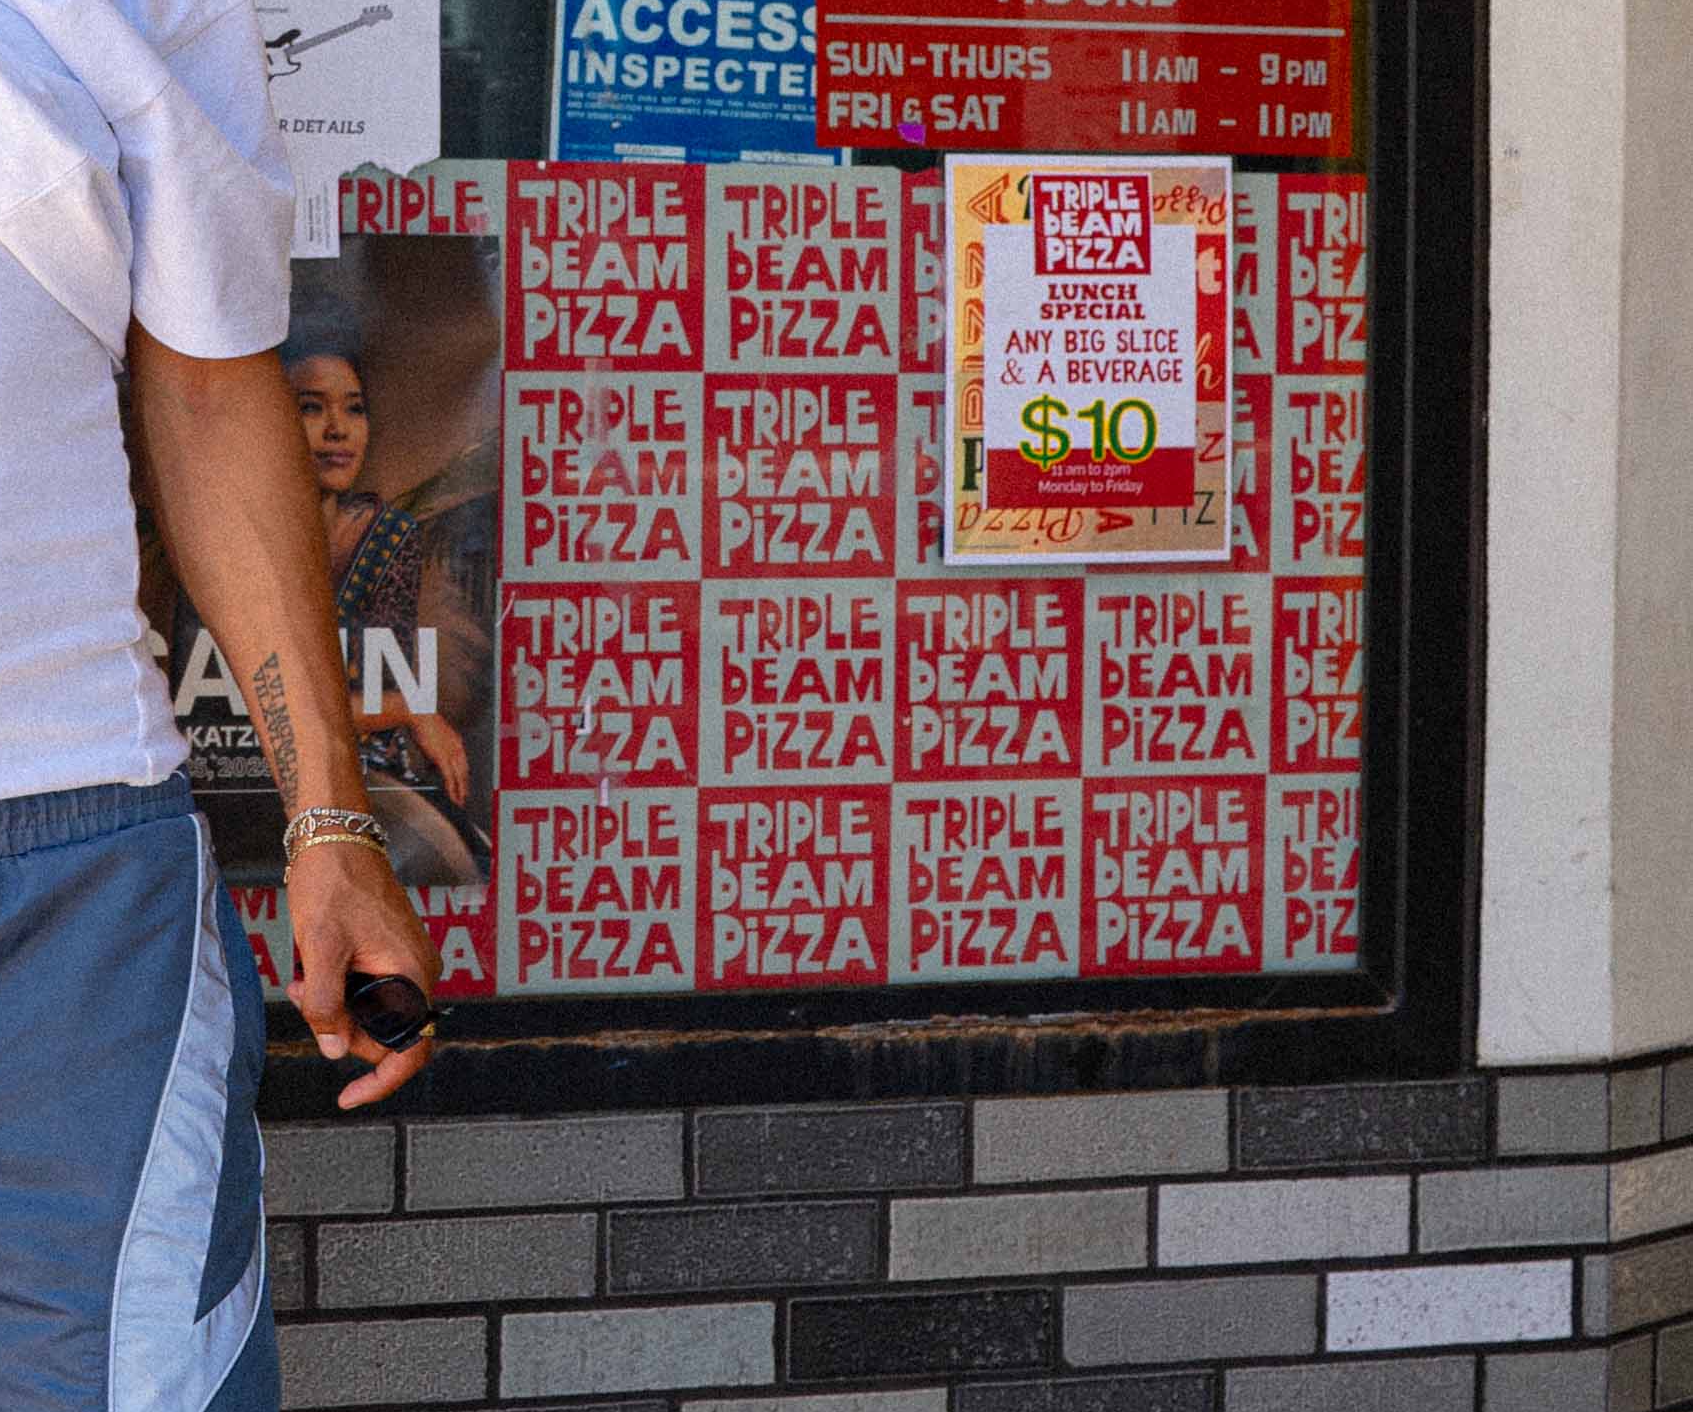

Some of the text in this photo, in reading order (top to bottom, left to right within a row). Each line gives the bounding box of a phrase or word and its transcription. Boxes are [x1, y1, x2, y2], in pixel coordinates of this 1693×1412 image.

[567, 50, 816, 97] INSPECTE
[1121, 45, 1197, 85] 11AM
[1260, 51, 1328, 86] 9PM
[827, 90, 891, 130] FRI
[903, 96, 923, 124] &
[934, 94, 1005, 131] SAT
[1120, 99, 1196, 138] 11AM
[1258, 103, 1332, 139] 11PM
[519, 179, 686, 237] TRIPLE
[1040, 180, 1138, 212] TRIPLE
[1048, 283, 1137, 300] LUNCH
[1040, 302, 1146, 321] SPECIAL
[1005, 329, 1179, 354] ANY BIG SLICE
[1000, 359, 1183, 385] & A BEVERAGE
[1018, 393, 1159, 470] $10
[1065, 465, 1086, 476] am
[1087, 463, 1100, 476] to
[1038, 479, 1144, 495] Monday to Friday
[1097, 590, 1252, 648] TRIPLE
